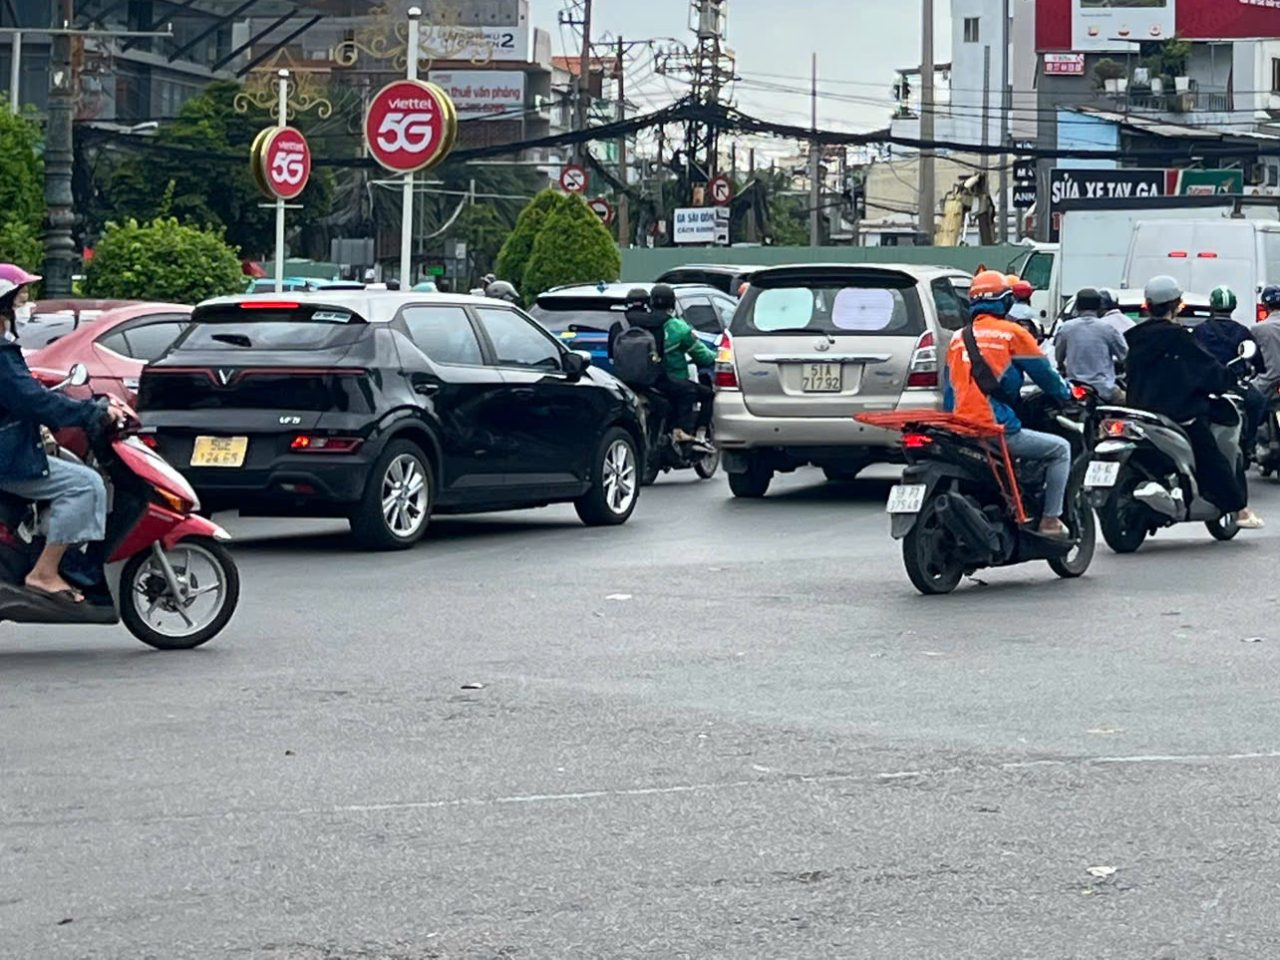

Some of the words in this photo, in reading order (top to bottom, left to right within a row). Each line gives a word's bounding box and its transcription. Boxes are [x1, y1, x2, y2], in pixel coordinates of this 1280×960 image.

[501, 33, 514, 49] 2
[388, 98, 433, 109] viettel
[377, 113, 433, 153] 5G
[271, 152, 304, 185] 5G
[1052, 173, 1079, 203] SỬA
[1137, 182, 1159, 198] GA
[811, 364, 831, 377] 51A
